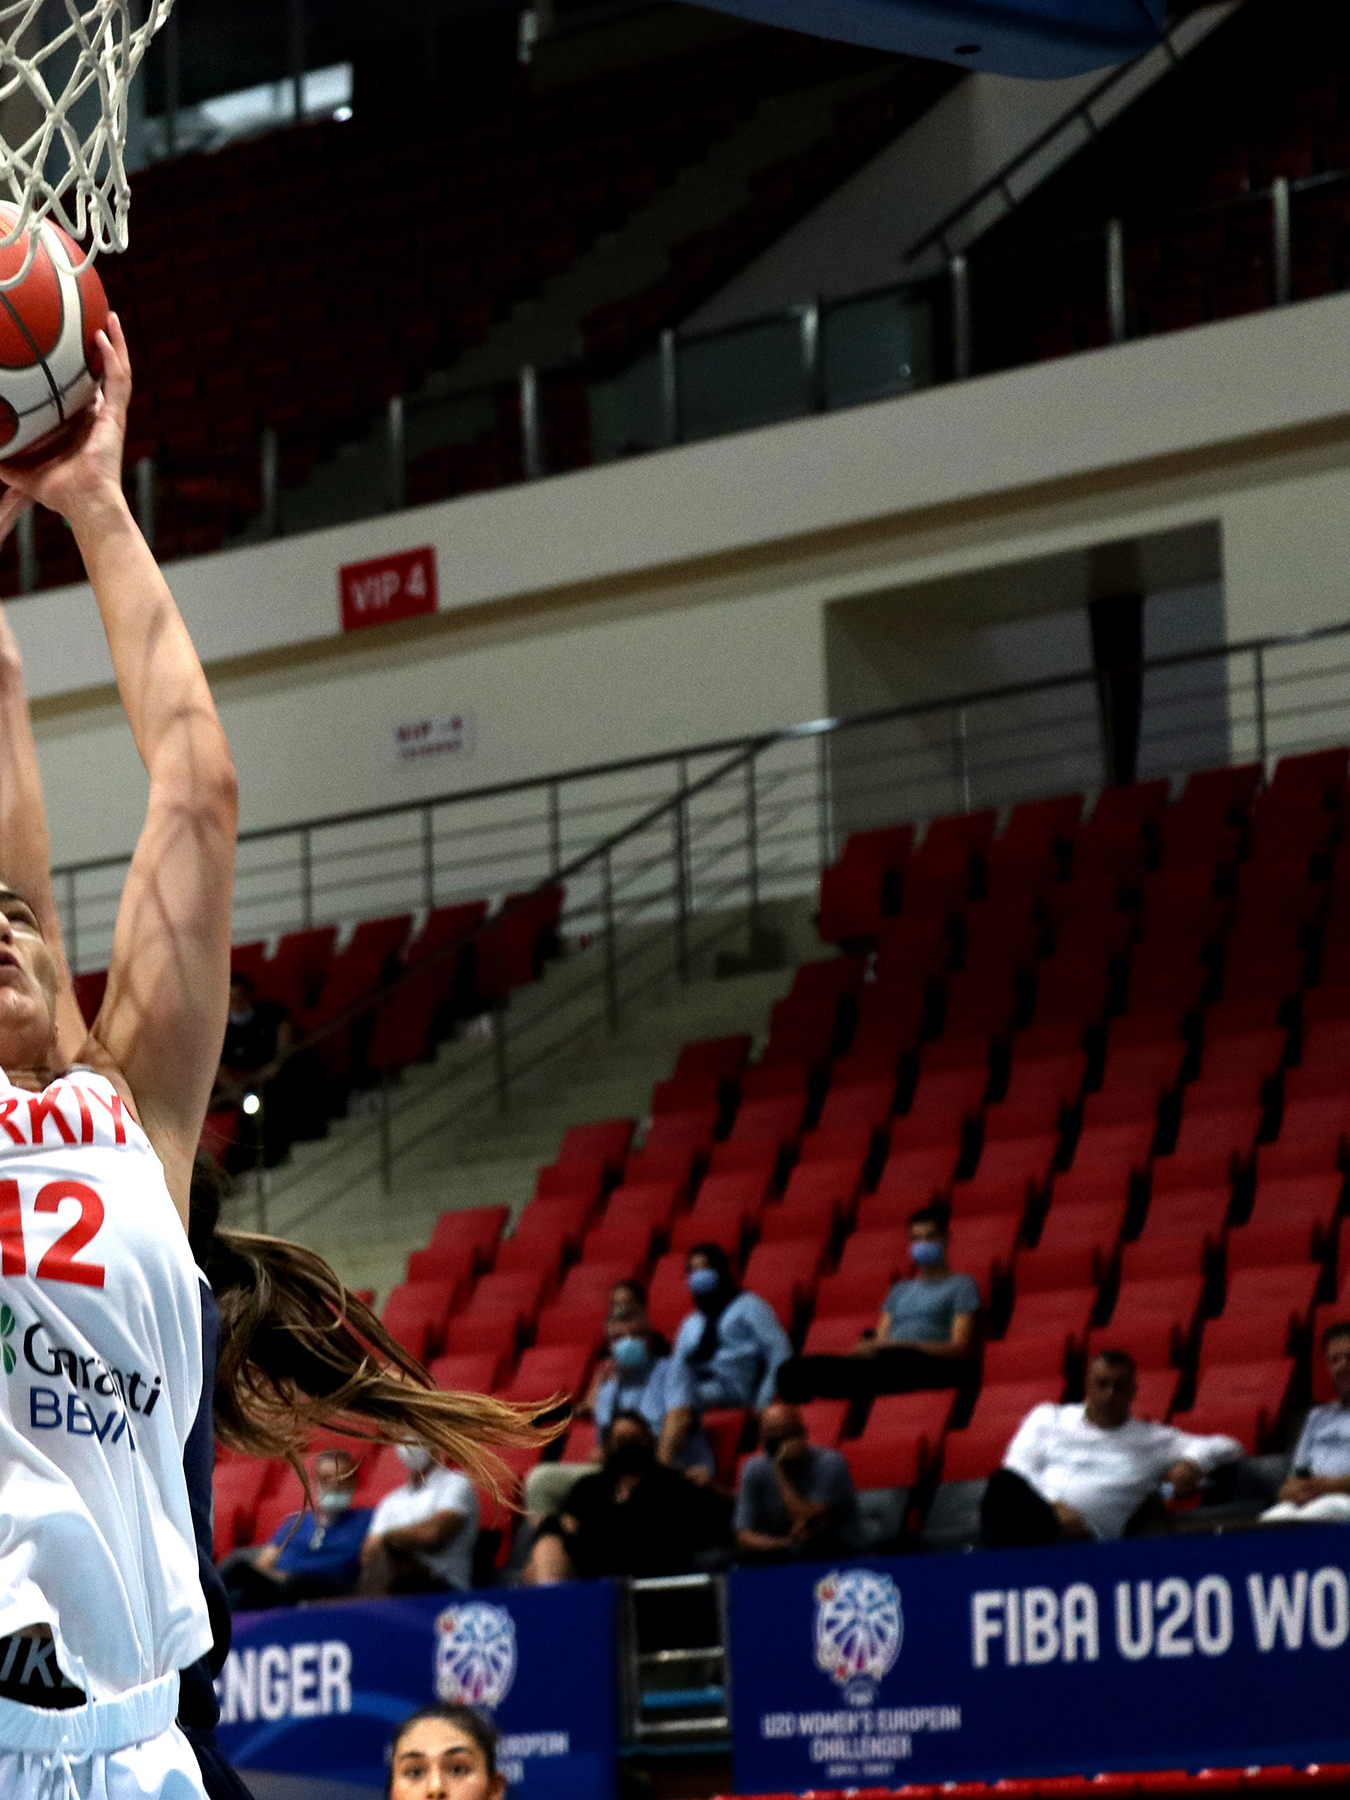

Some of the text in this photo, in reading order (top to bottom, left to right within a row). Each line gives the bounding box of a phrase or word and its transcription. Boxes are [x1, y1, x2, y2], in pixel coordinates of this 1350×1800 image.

[350, 561, 427, 615] VIP 4
[970, 1565, 1350, 1669] FIBA U20 WO
[762, 1705, 962, 1739] U20 WOMEN'S EUROPEAN
